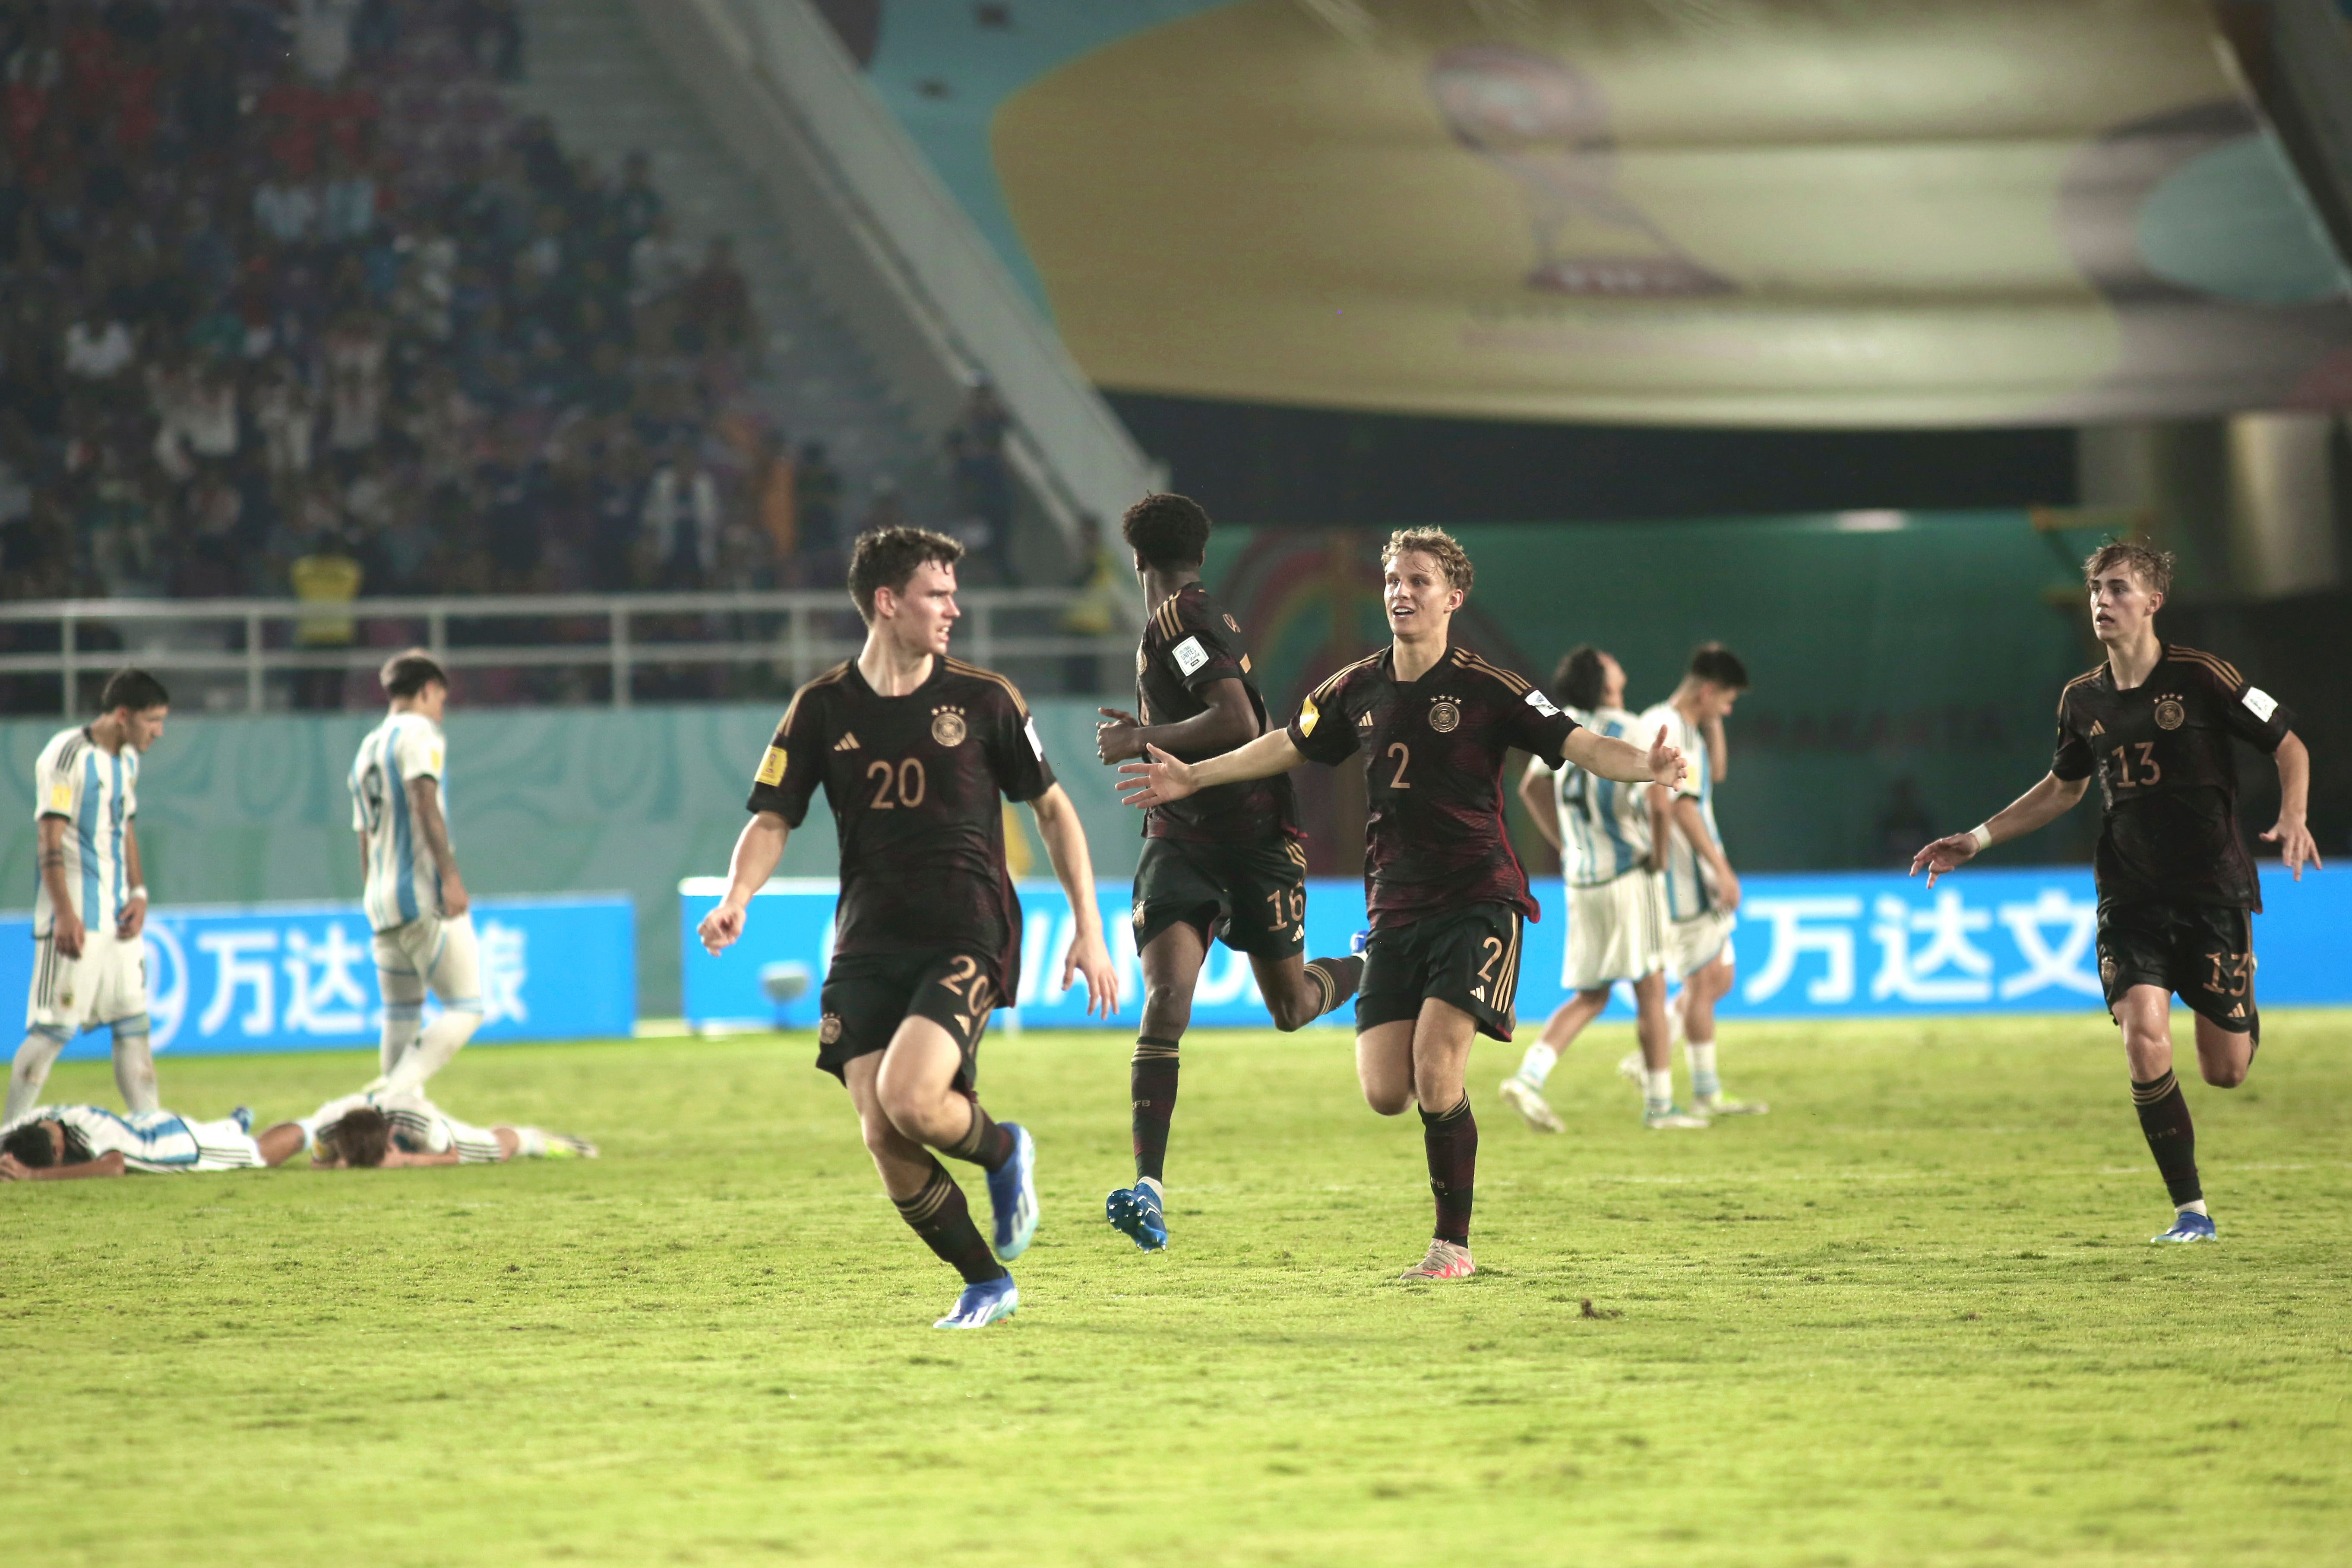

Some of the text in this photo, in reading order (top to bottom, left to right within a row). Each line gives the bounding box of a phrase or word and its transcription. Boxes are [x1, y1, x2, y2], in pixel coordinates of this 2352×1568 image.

[1181, 648, 1196, 660] UNITES
[866, 757, 925, 809] 20
[1387, 742, 1410, 789] 2
[2111, 742, 2161, 788] 13
[1267, 880, 1304, 932] 16
[1477, 937, 1502, 983] 2
[2203, 952, 2249, 997] 13
[938, 954, 990, 1017] 20
[1430, 1176, 1445, 1189] FB
